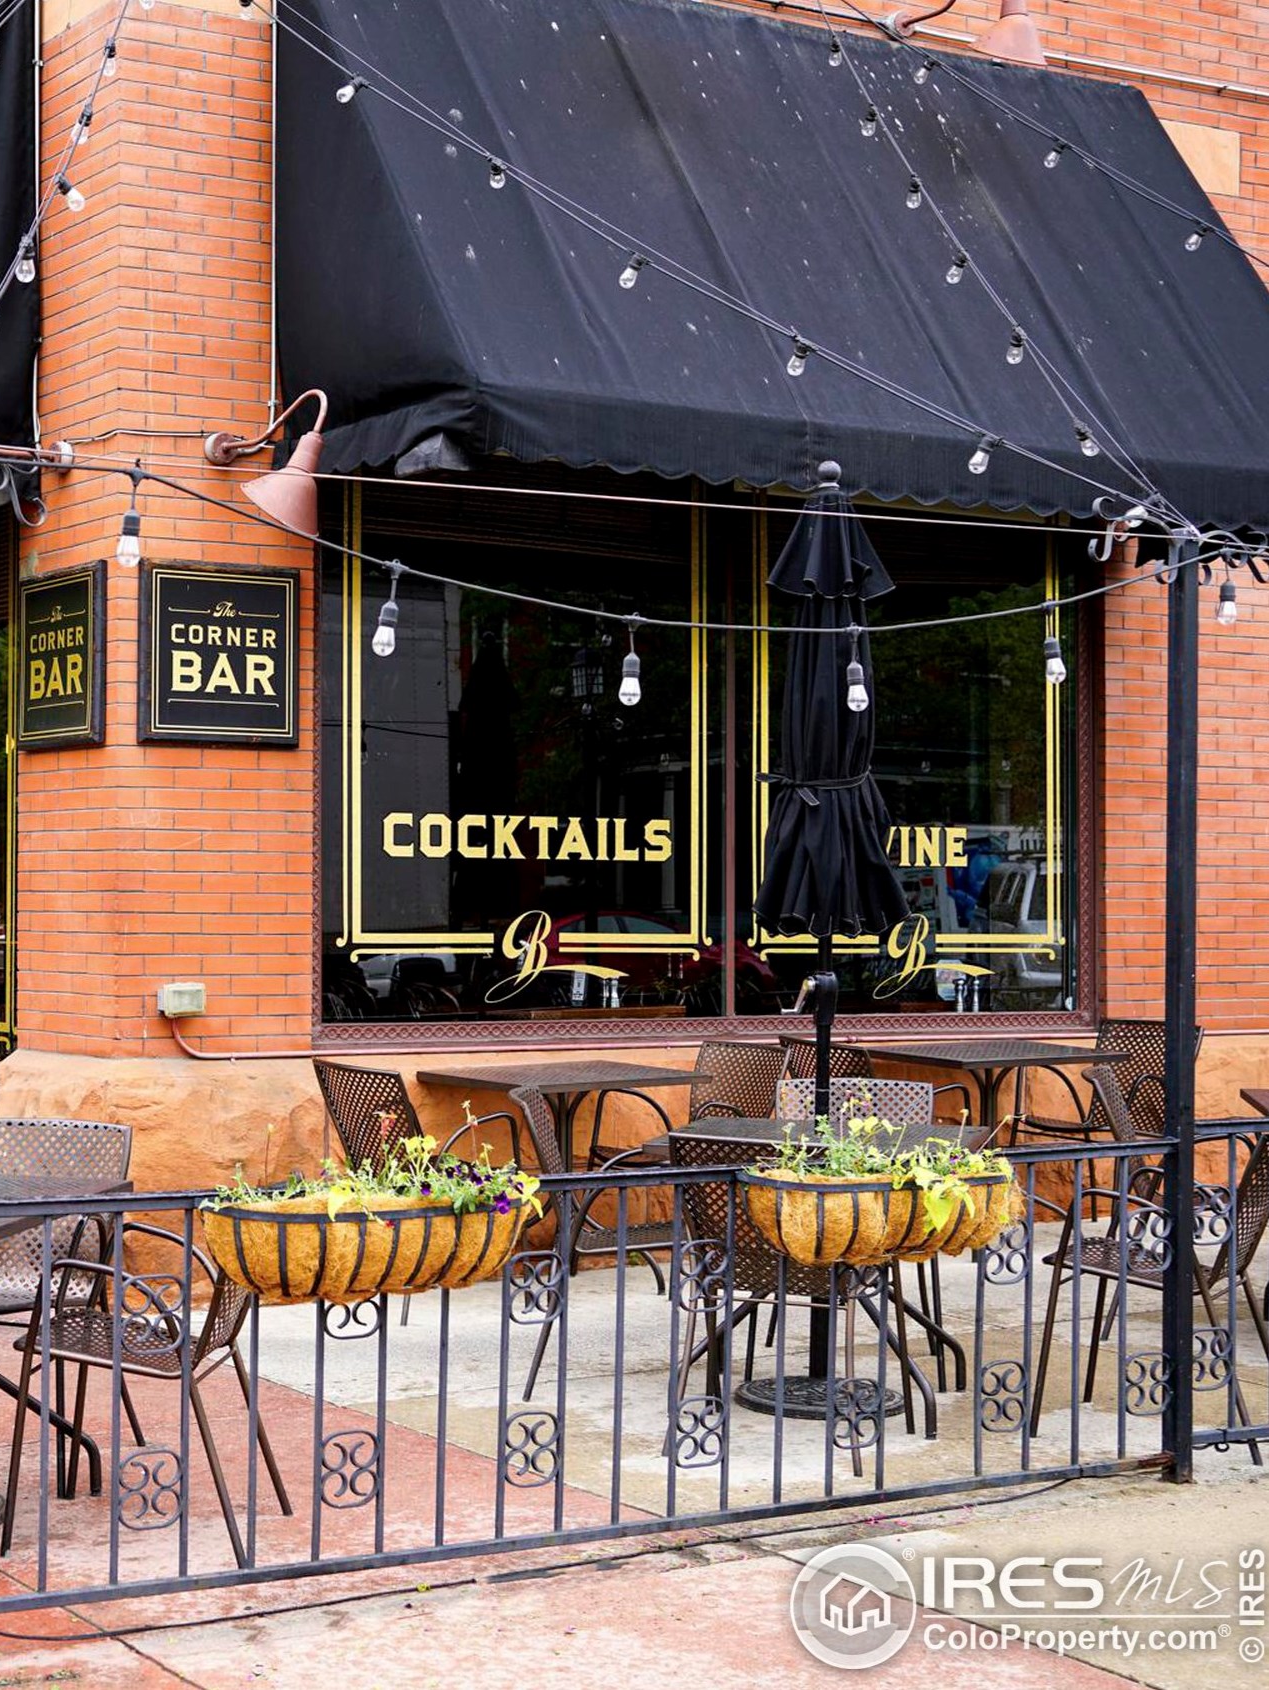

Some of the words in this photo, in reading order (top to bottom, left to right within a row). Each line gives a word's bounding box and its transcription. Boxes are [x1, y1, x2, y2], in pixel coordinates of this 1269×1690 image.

[212, 600, 237, 618] The
[29, 625, 85, 655] CORNER
[170, 623, 278, 650] CORNER
[29, 653, 84, 701] BAR
[170, 650, 278, 696] BAR
[382, 811, 673, 862] COCKTAILS
